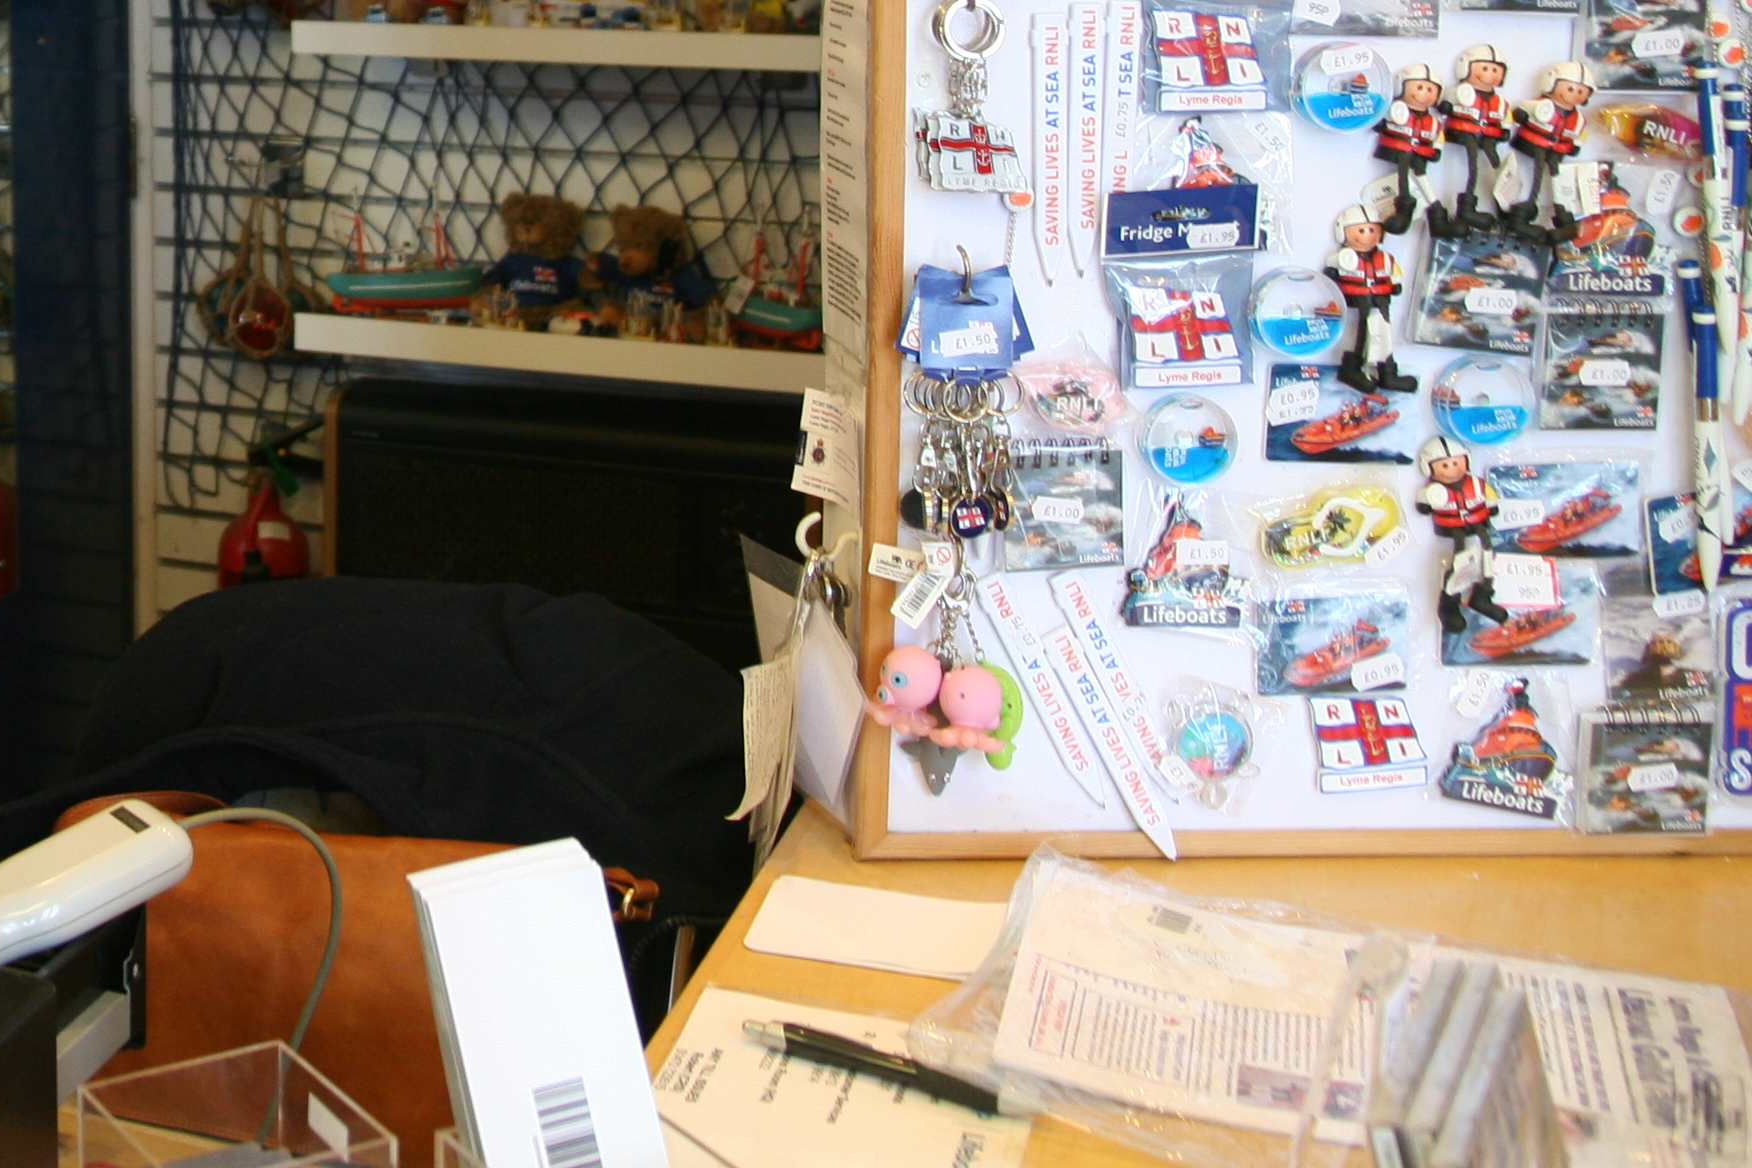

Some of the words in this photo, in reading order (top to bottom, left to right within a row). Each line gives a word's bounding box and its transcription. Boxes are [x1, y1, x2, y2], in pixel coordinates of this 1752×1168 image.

[1306, 1, 1329, 16] 95P
[1082, 9, 1097, 50] RNLI
[1120, 5, 1136, 46] RNLI
[1045, 25, 1060, 66] RNLI
[1644, 37, 1681, 51] £1.00
[1118, 51, 1134, 85] SEA
[1333, 51, 1370, 67] £1.95
[1082, 53, 1097, 90] SEA
[1045, 70, 1060, 105] SEA
[1082, 91, 1097, 113] AT
[1179, 93, 1210, 107] Lyme
[1212, 93, 1244, 106] Regis
[1045, 106, 1060, 129] AT
[1114, 100, 1130, 139] £0.75
[1327, 105, 1375, 119] Lifeboats
[1081, 116, 1097, 164] LIVES
[1643, 120, 1687, 145] RNLI
[1045, 132, 1060, 180] LIVES
[1081, 165, 1096, 230] SAVING
[1045, 181, 1059, 246] SAVING
[1722, 196, 1732, 232] RNLI
[1119, 223, 1173, 244] Fridge
[1200, 231, 1236, 244] £1.95
[1568, 271, 1653, 293] Lifeboats
[1477, 296, 1514, 310] £1.00
[954, 333, 992, 351] £1.50
[1282, 330, 1331, 346] Lifeboats
[1488, 339, 1531, 354] Lifeboats
[1158, 370, 1188, 383] Lyme
[1191, 370, 1223, 382] Regis
[1591, 367, 1629, 382] £1.00
[1055, 396, 1101, 413] RNLI
[1278, 389, 1316, 407] £0.95
[1470, 420, 1519, 435] Lifeboats
[1613, 416, 1656, 429] Lifeboats
[1044, 506, 1080, 519] £1.00
[1503, 507, 1541, 523] £0.95
[1284, 529, 1330, 552] RNLI
[1078, 552, 1121, 565] Lifeboats
[1188, 546, 1225, 560] £1.50
[1506, 563, 1543, 576] £1.95
[986, 580, 1014, 620] RNLI
[1063, 580, 1093, 621] RNLI
[1142, 605, 1228, 624] Lifeboats
[1084, 617, 1111, 652] SEA
[1054, 634, 1084, 674] RNLI
[1098, 648, 1121, 671] AT
[1363, 665, 1400, 683] £0.95
[1031, 672, 1064, 722] LIVES
[1075, 671, 1103, 707] SEA
[1658, 685, 1710, 701] Lifeboats
[1090, 703, 1111, 725] AT
[1053, 715, 1091, 773] SAVING
[1101, 725, 1133, 774] LIVES
[1339, 774, 1371, 787] Lyme
[1374, 771, 1404, 784] Regis
[1638, 769, 1675, 783] £1.00
[1123, 769, 1162, 827] SAVING
[1461, 781, 1545, 814] Lifeboats
[1660, 819, 1703, 832] Lifeboats
